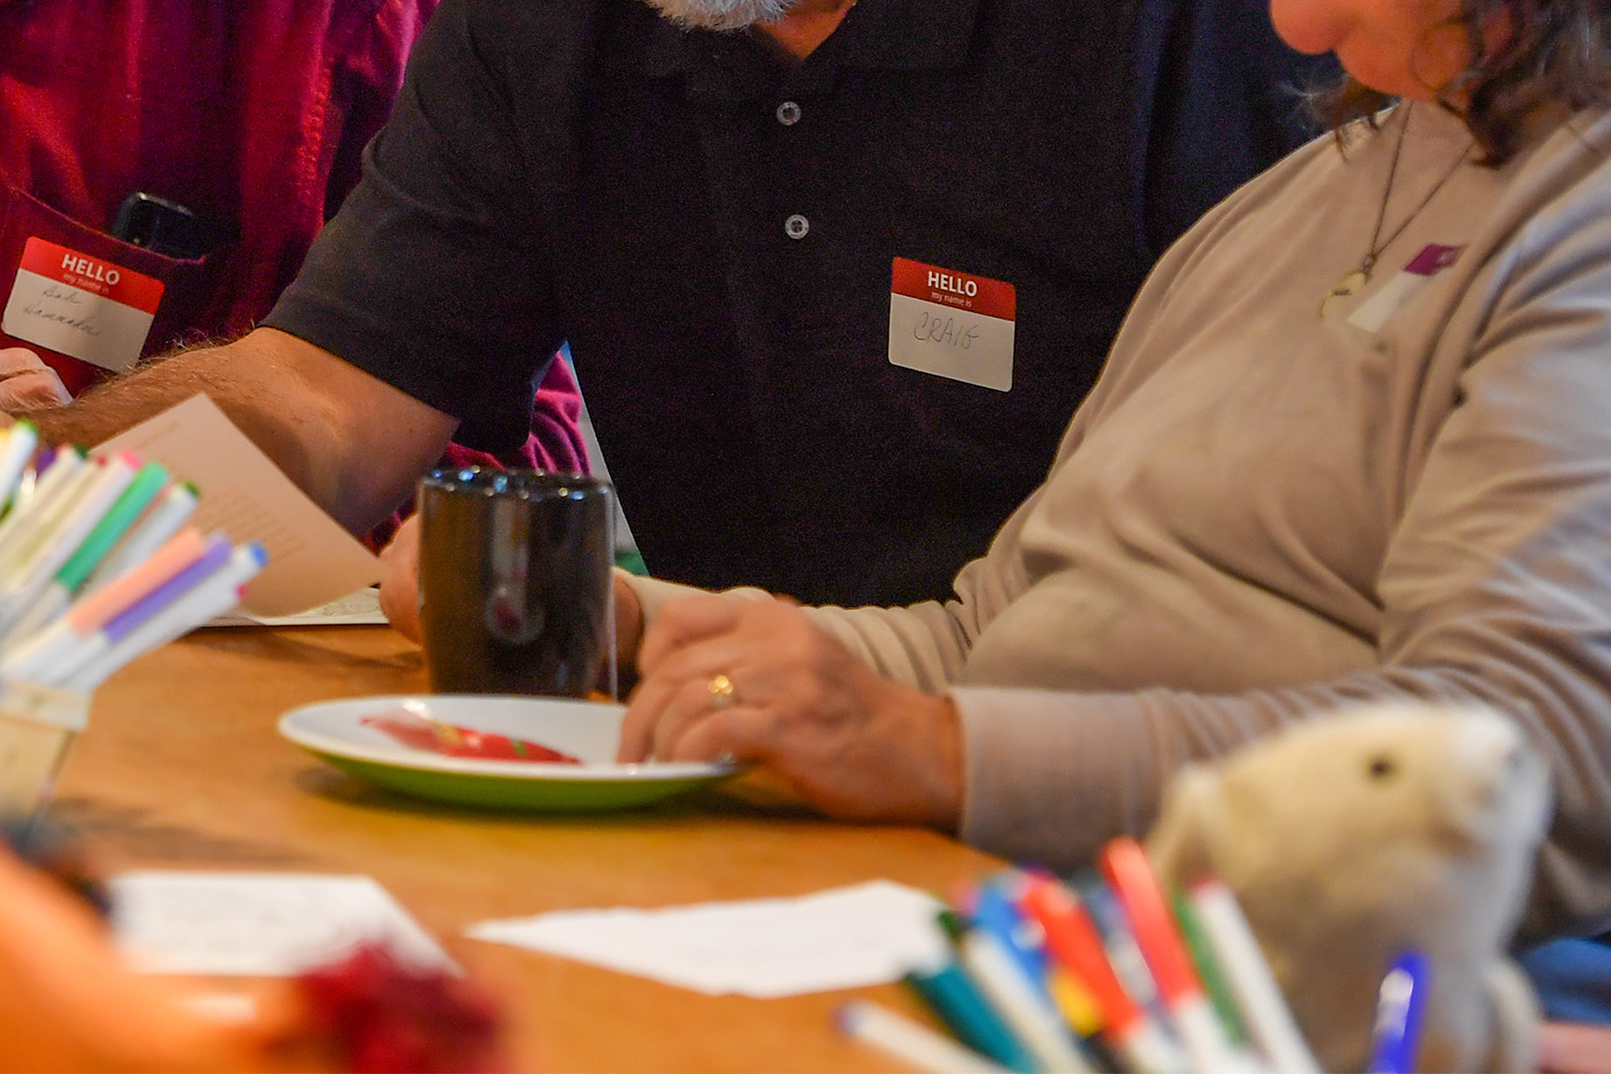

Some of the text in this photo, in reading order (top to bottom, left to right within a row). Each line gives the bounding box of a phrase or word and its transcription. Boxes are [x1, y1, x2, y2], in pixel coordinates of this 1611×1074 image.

[61, 253, 121, 286] HELLO
[927, 270, 978, 298] HELLO
[931, 291, 943, 303] my
[944, 295, 965, 306] name
[913, 311, 980, 350] CRAIG
